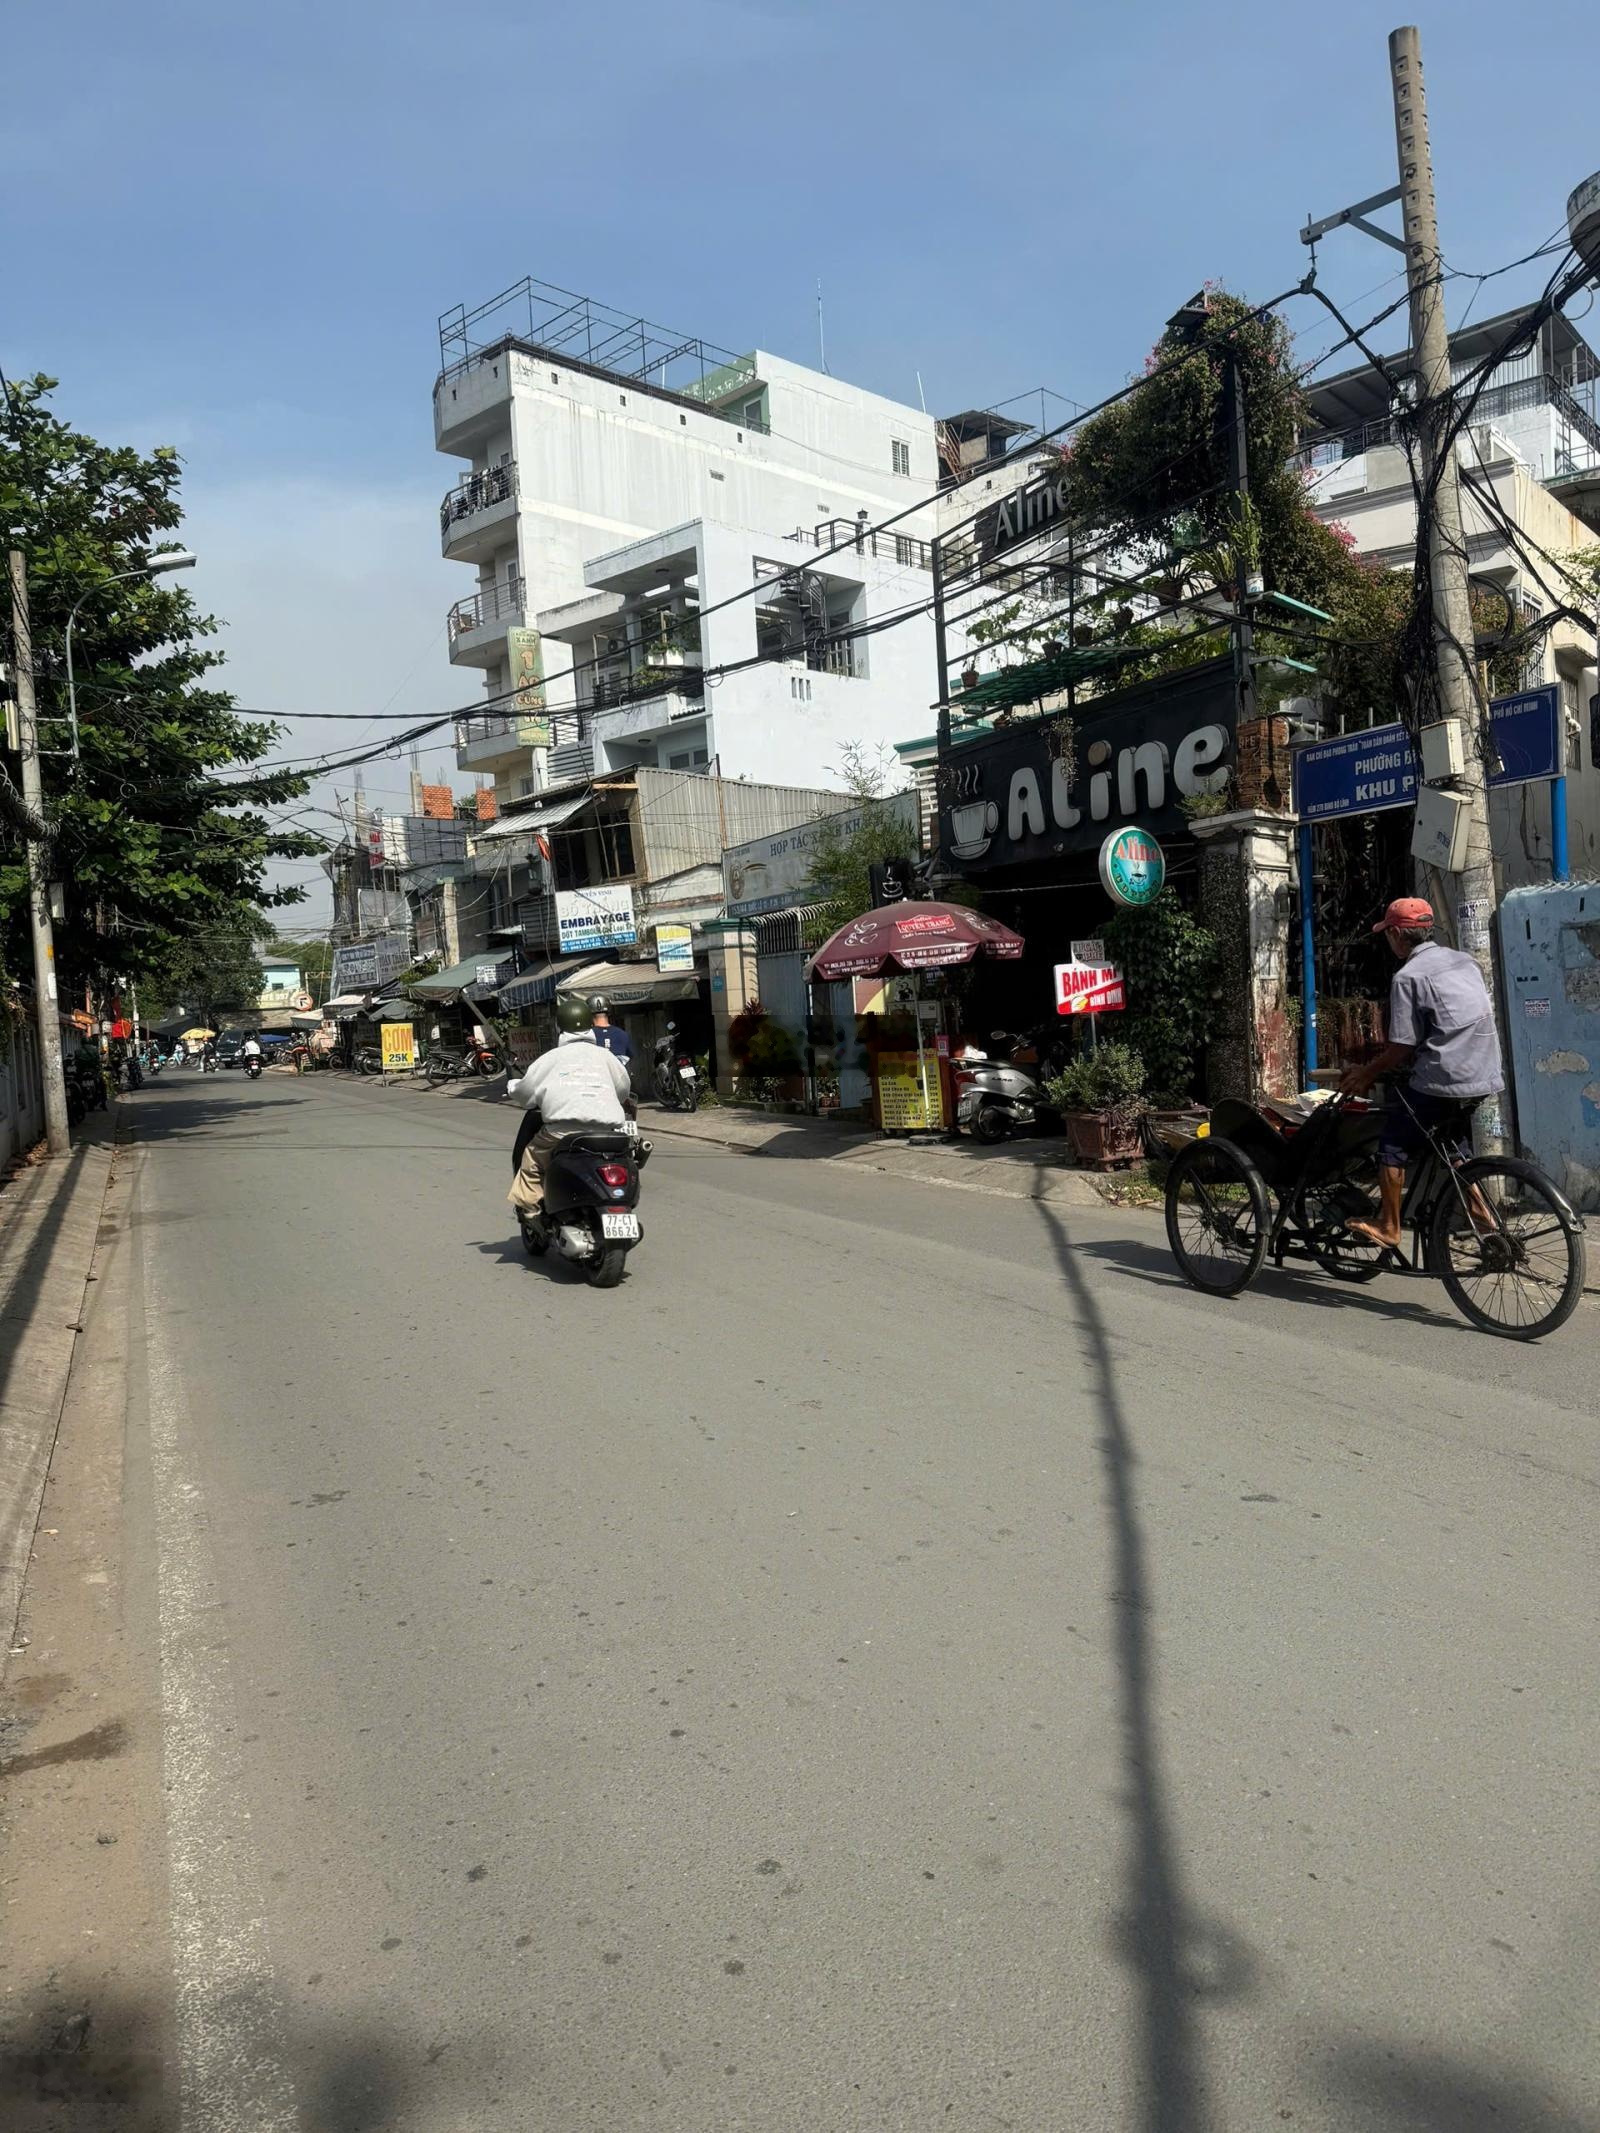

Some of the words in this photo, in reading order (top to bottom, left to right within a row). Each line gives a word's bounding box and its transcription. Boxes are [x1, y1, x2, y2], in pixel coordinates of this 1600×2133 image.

[994, 478, 1072, 546] Aline
[520, 650, 535, 670] 1
[1355, 752, 1401, 775] PHƯỜNG
[1355, 778, 1396, 801] KHU
[1402, 775, 1415, 793] P
[770, 838, 788, 858] HỢP
[791, 830, 808, 851] TÁC
[560, 912, 631, 930] EMBRAYAGE
[1062, 967, 1097, 998] BÁNH
[384, 1026, 412, 1052] CƠM
[388, 1053, 408, 1063] 25K
[607, 1215, 632, 1226] 77-C1
